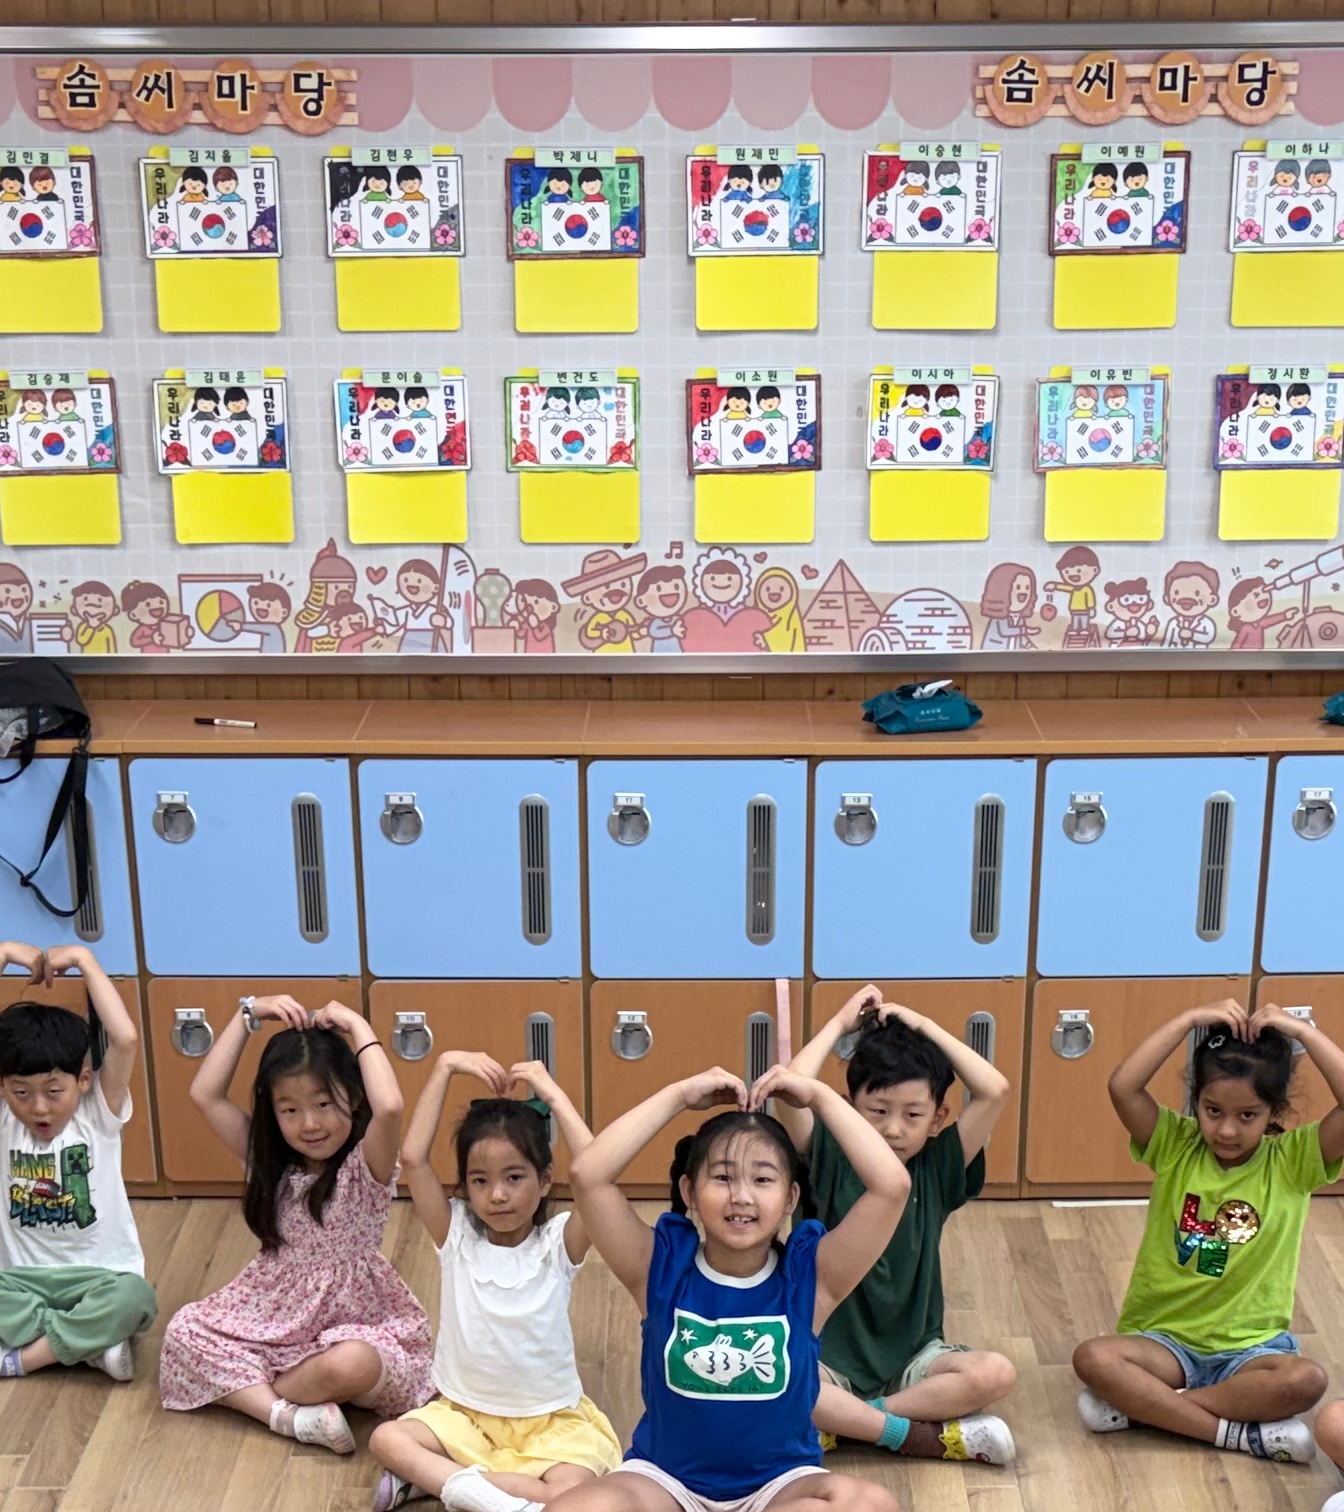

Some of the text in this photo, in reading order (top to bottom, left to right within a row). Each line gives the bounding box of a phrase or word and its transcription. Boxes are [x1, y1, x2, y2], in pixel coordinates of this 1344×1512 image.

[62, 64, 332, 117] 솜씨마당
[1001, 58, 1277, 107] 솜씨마당
[370, 150, 412, 162] 김현우
[553, 151, 596, 162] 박제니
[918, 145, 961, 157] 이승현
[1285, 143, 1328, 155] 이하나
[70, 166, 85, 223] 대한민국
[155, 167, 169, 224] 우리나라
[618, 168, 631, 217] 대한민
[1063, 163, 1077, 221] 우리나라
[735, 371, 777, 382] 이소원
[911, 369, 953, 380] 이시아
[1090, 369, 1132, 380] 이유빈
[1267, 368, 1310, 380] 정시환
[167, 386, 183, 442] 우리나라
[696, 387, 712, 442] 우리나라
